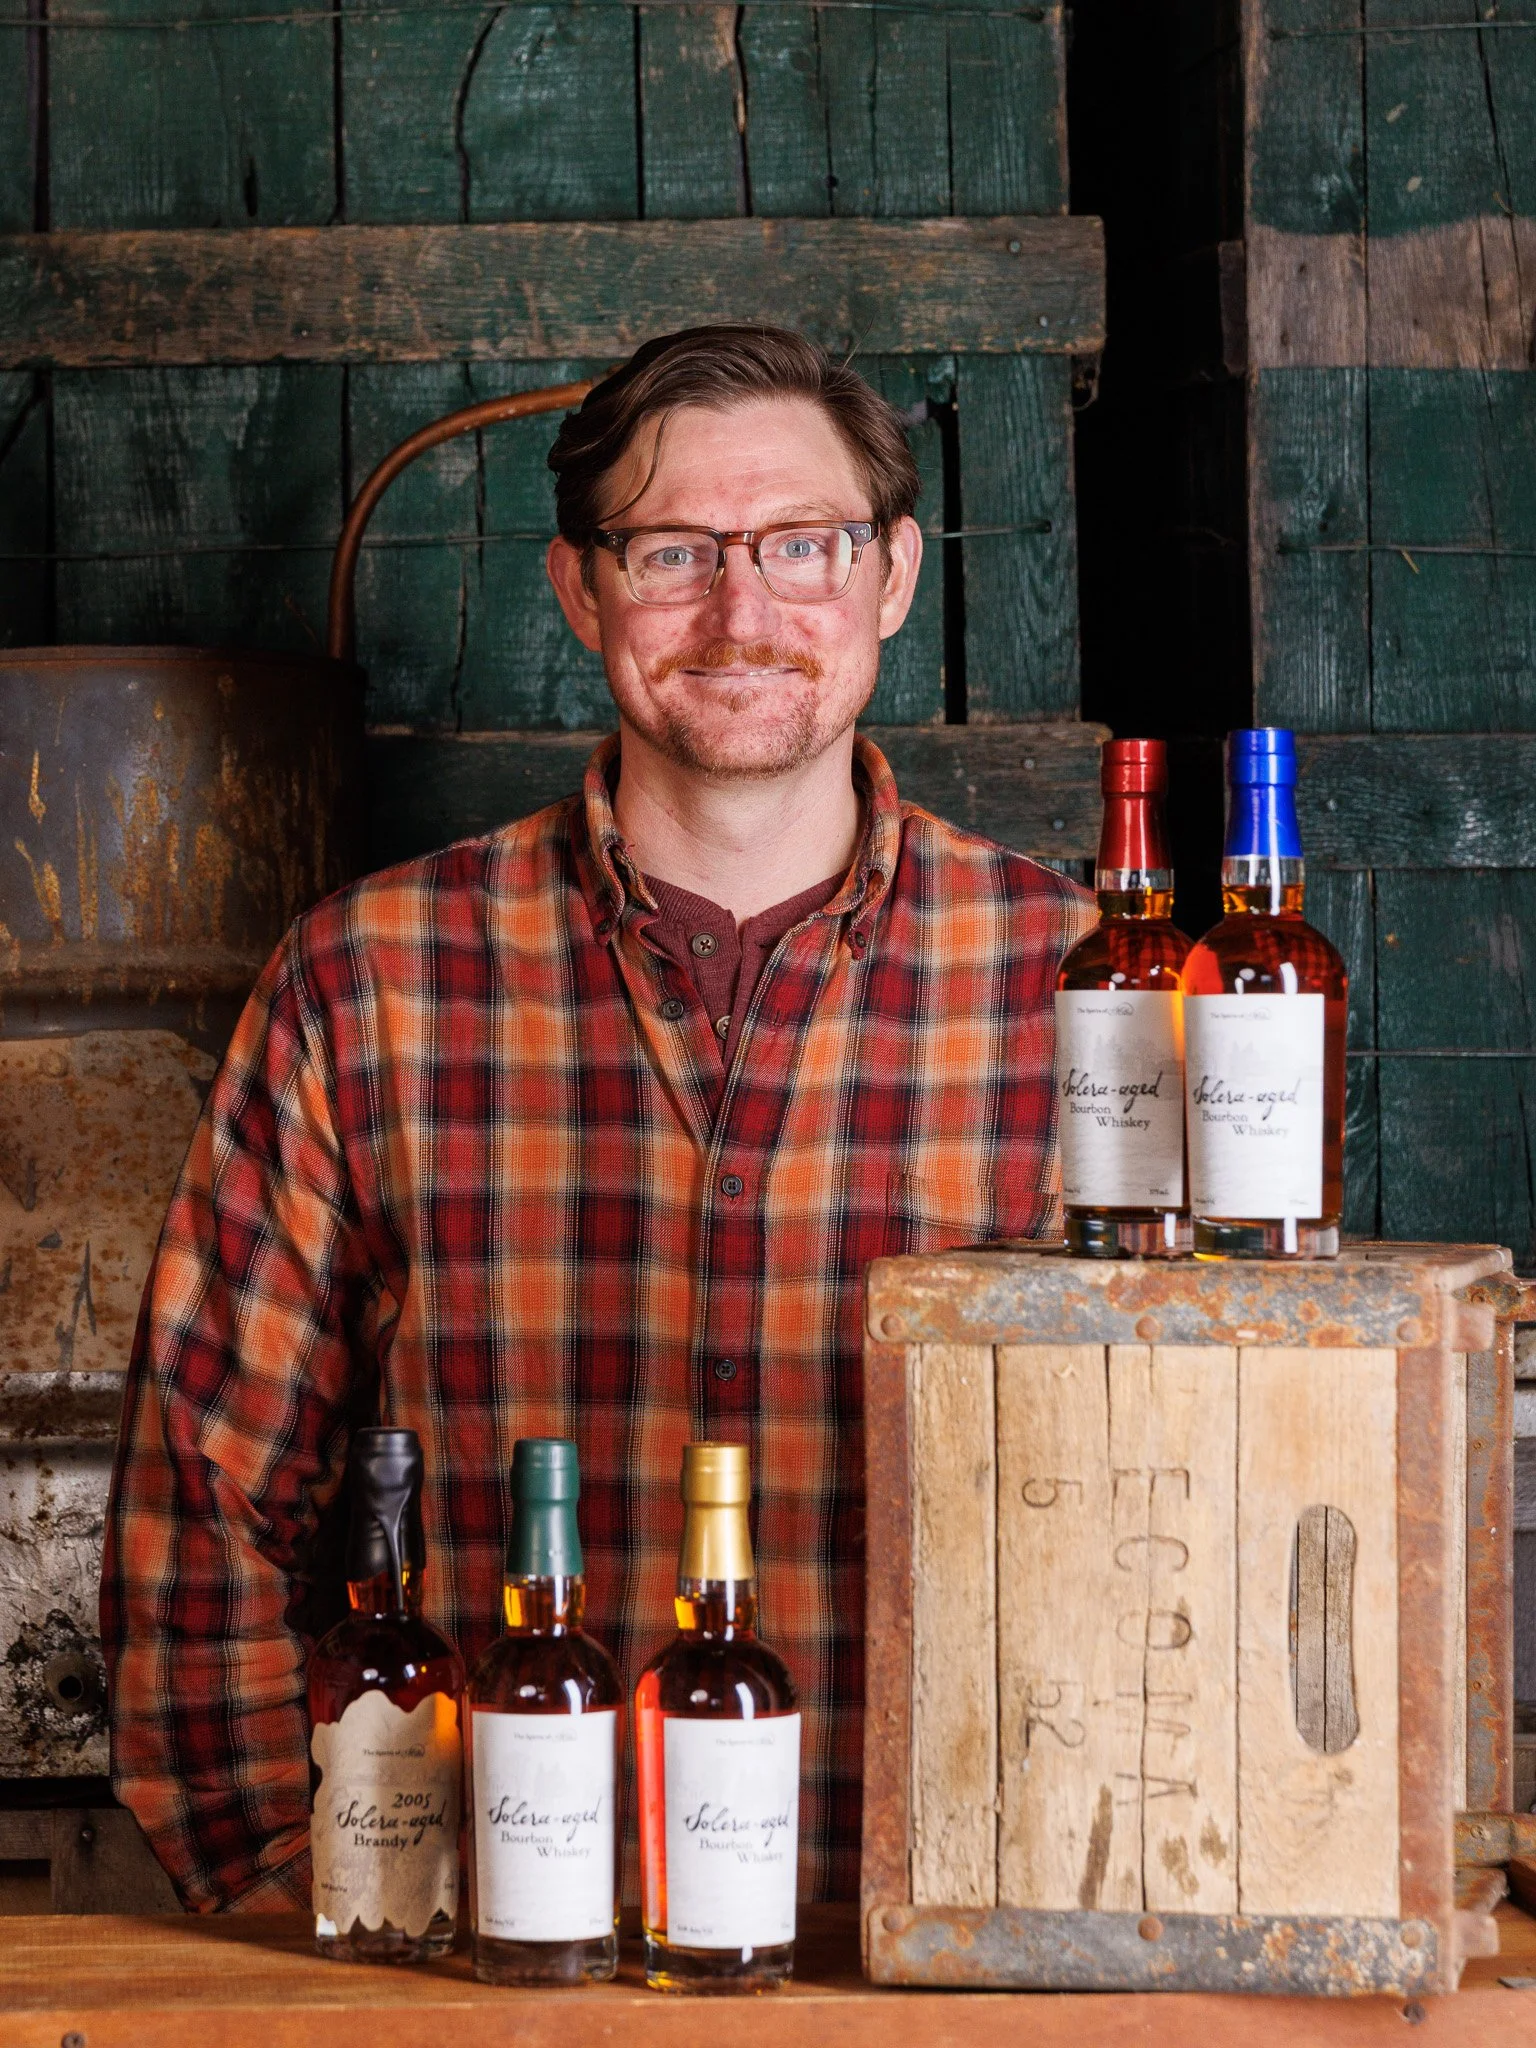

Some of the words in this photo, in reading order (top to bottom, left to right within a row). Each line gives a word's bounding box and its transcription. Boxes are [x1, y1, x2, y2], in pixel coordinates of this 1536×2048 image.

[1062, 1068, 1163, 1114] Solera-aged
[1193, 1075, 1301, 1121] Solera-aged
[1070, 1101, 1112, 1114] Bourbon
[1202, 1110, 1248, 1122] Bourbon
[1096, 1116, 1151, 1131] Whiskey
[1232, 1124, 1289, 1139] Whiskey
[1021, 1476, 1083, 1510] 5
[1025, 1680, 1086, 1750] 52
[392, 1792, 432, 1809] 2005
[336, 1799, 447, 1846] Solera-aged
[487, 1795, 602, 1843] Solera-aged
[684, 1797, 791, 1847] Solera-aged
[354, 1833, 408, 1851] Brandy
[501, 1830, 553, 1843] Bourbon
[700, 1837, 752, 1849] Bourbon
[537, 1846, 590, 1858] Whiskey
